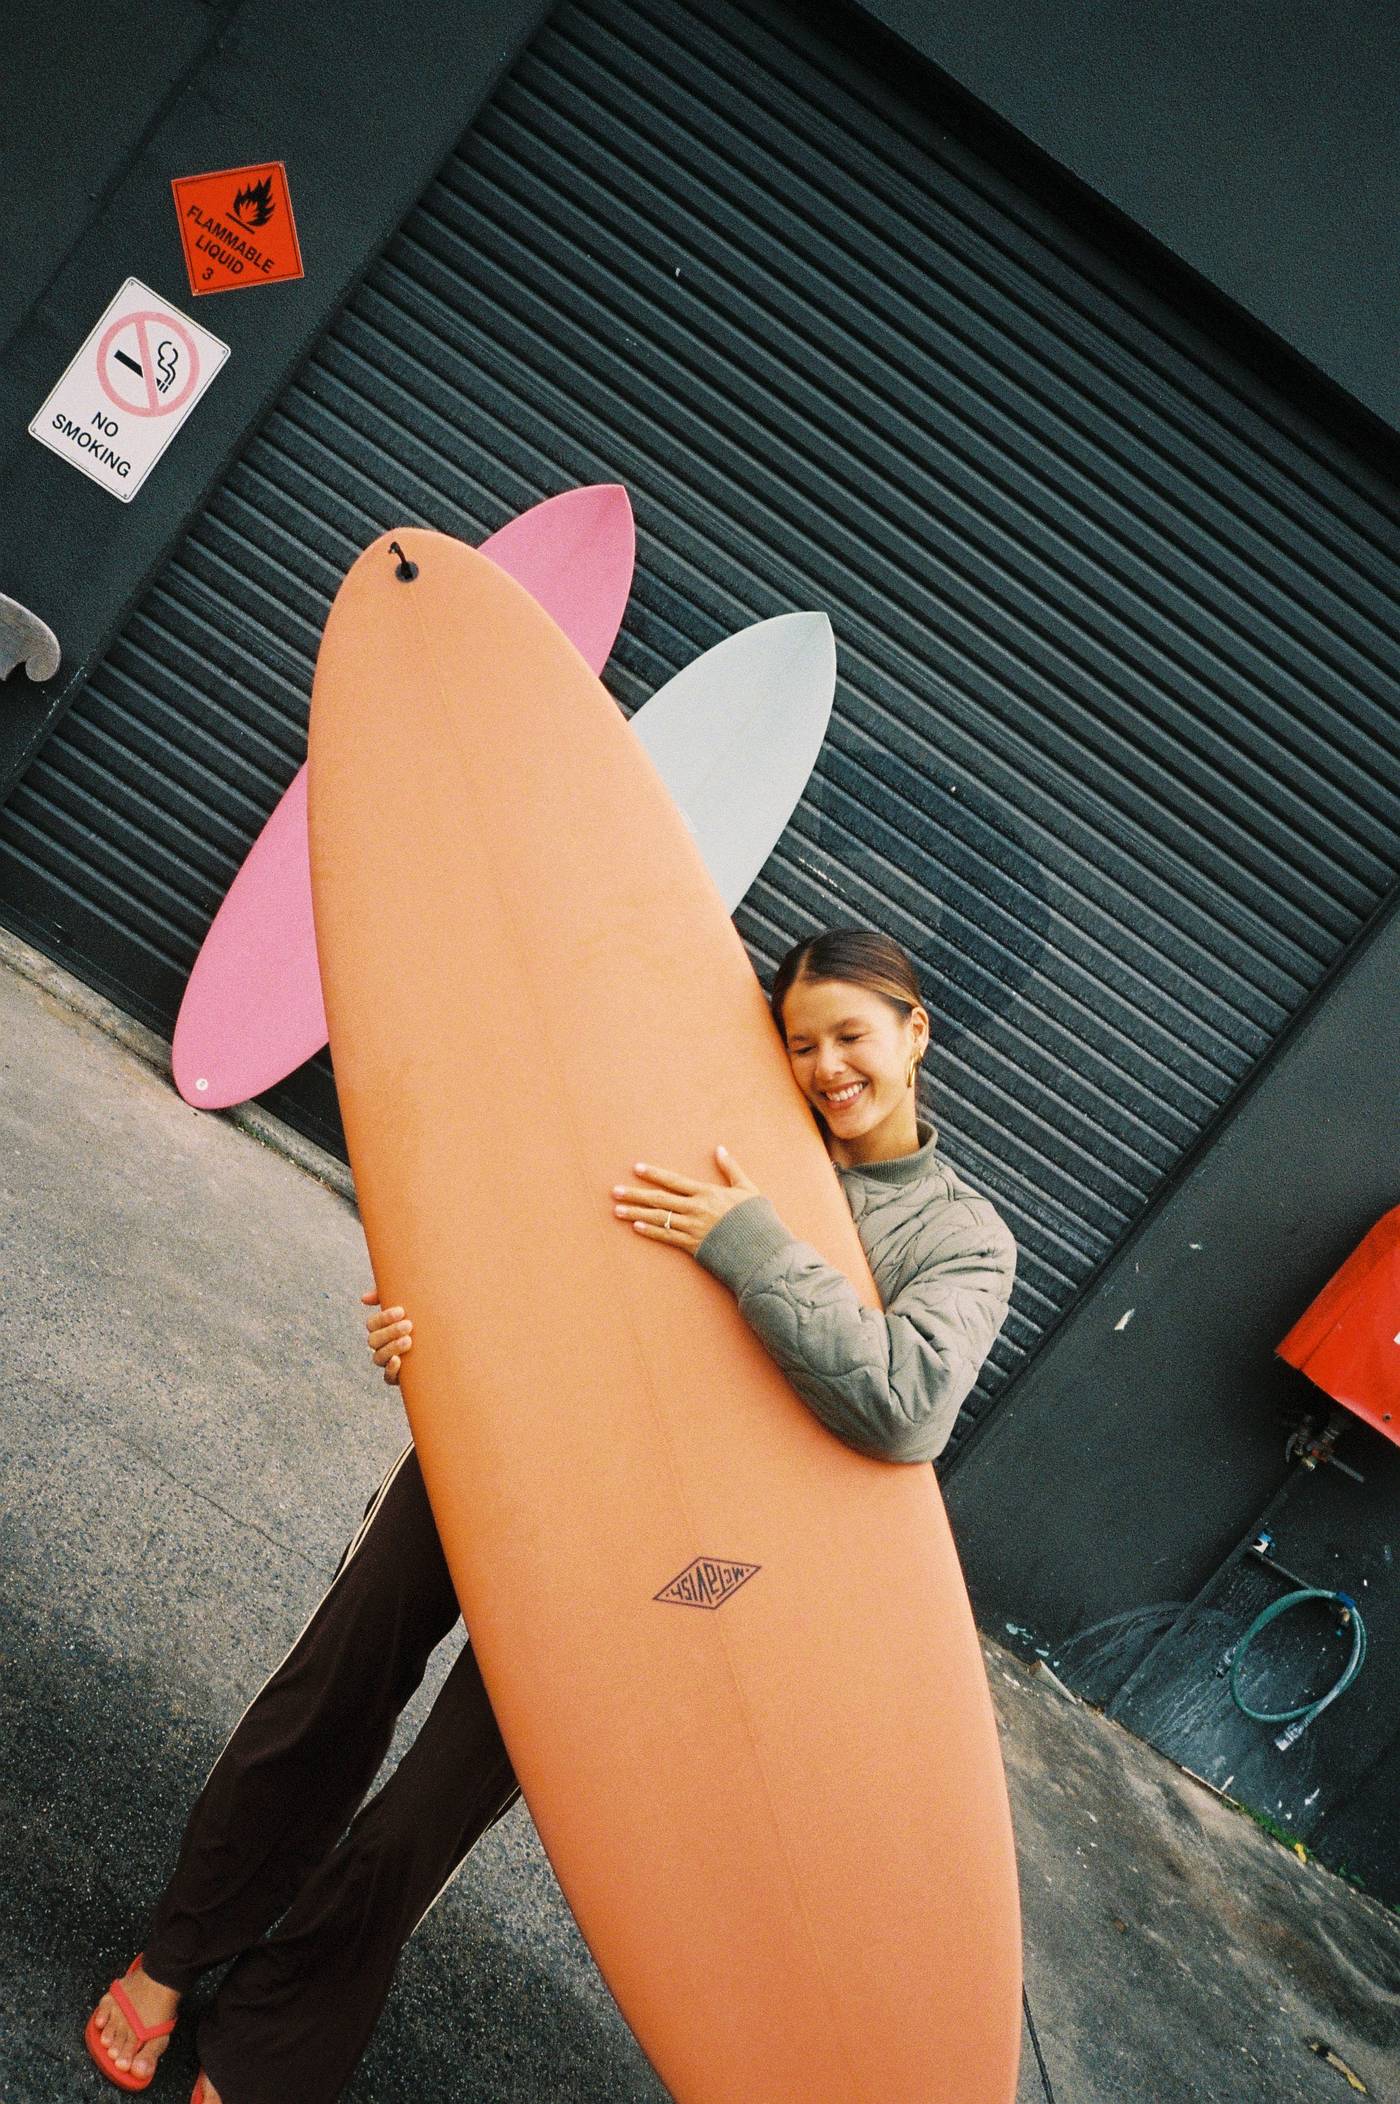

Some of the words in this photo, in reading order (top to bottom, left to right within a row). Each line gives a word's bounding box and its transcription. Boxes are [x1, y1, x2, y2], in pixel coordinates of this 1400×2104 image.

[187, 205, 275, 273] FLAMMABLE
[195, 235, 244, 274] LIQUID
[202, 267, 214, 280] 3
[91, 411, 118, 437] NO
[52, 414, 131, 478] SMOKING
